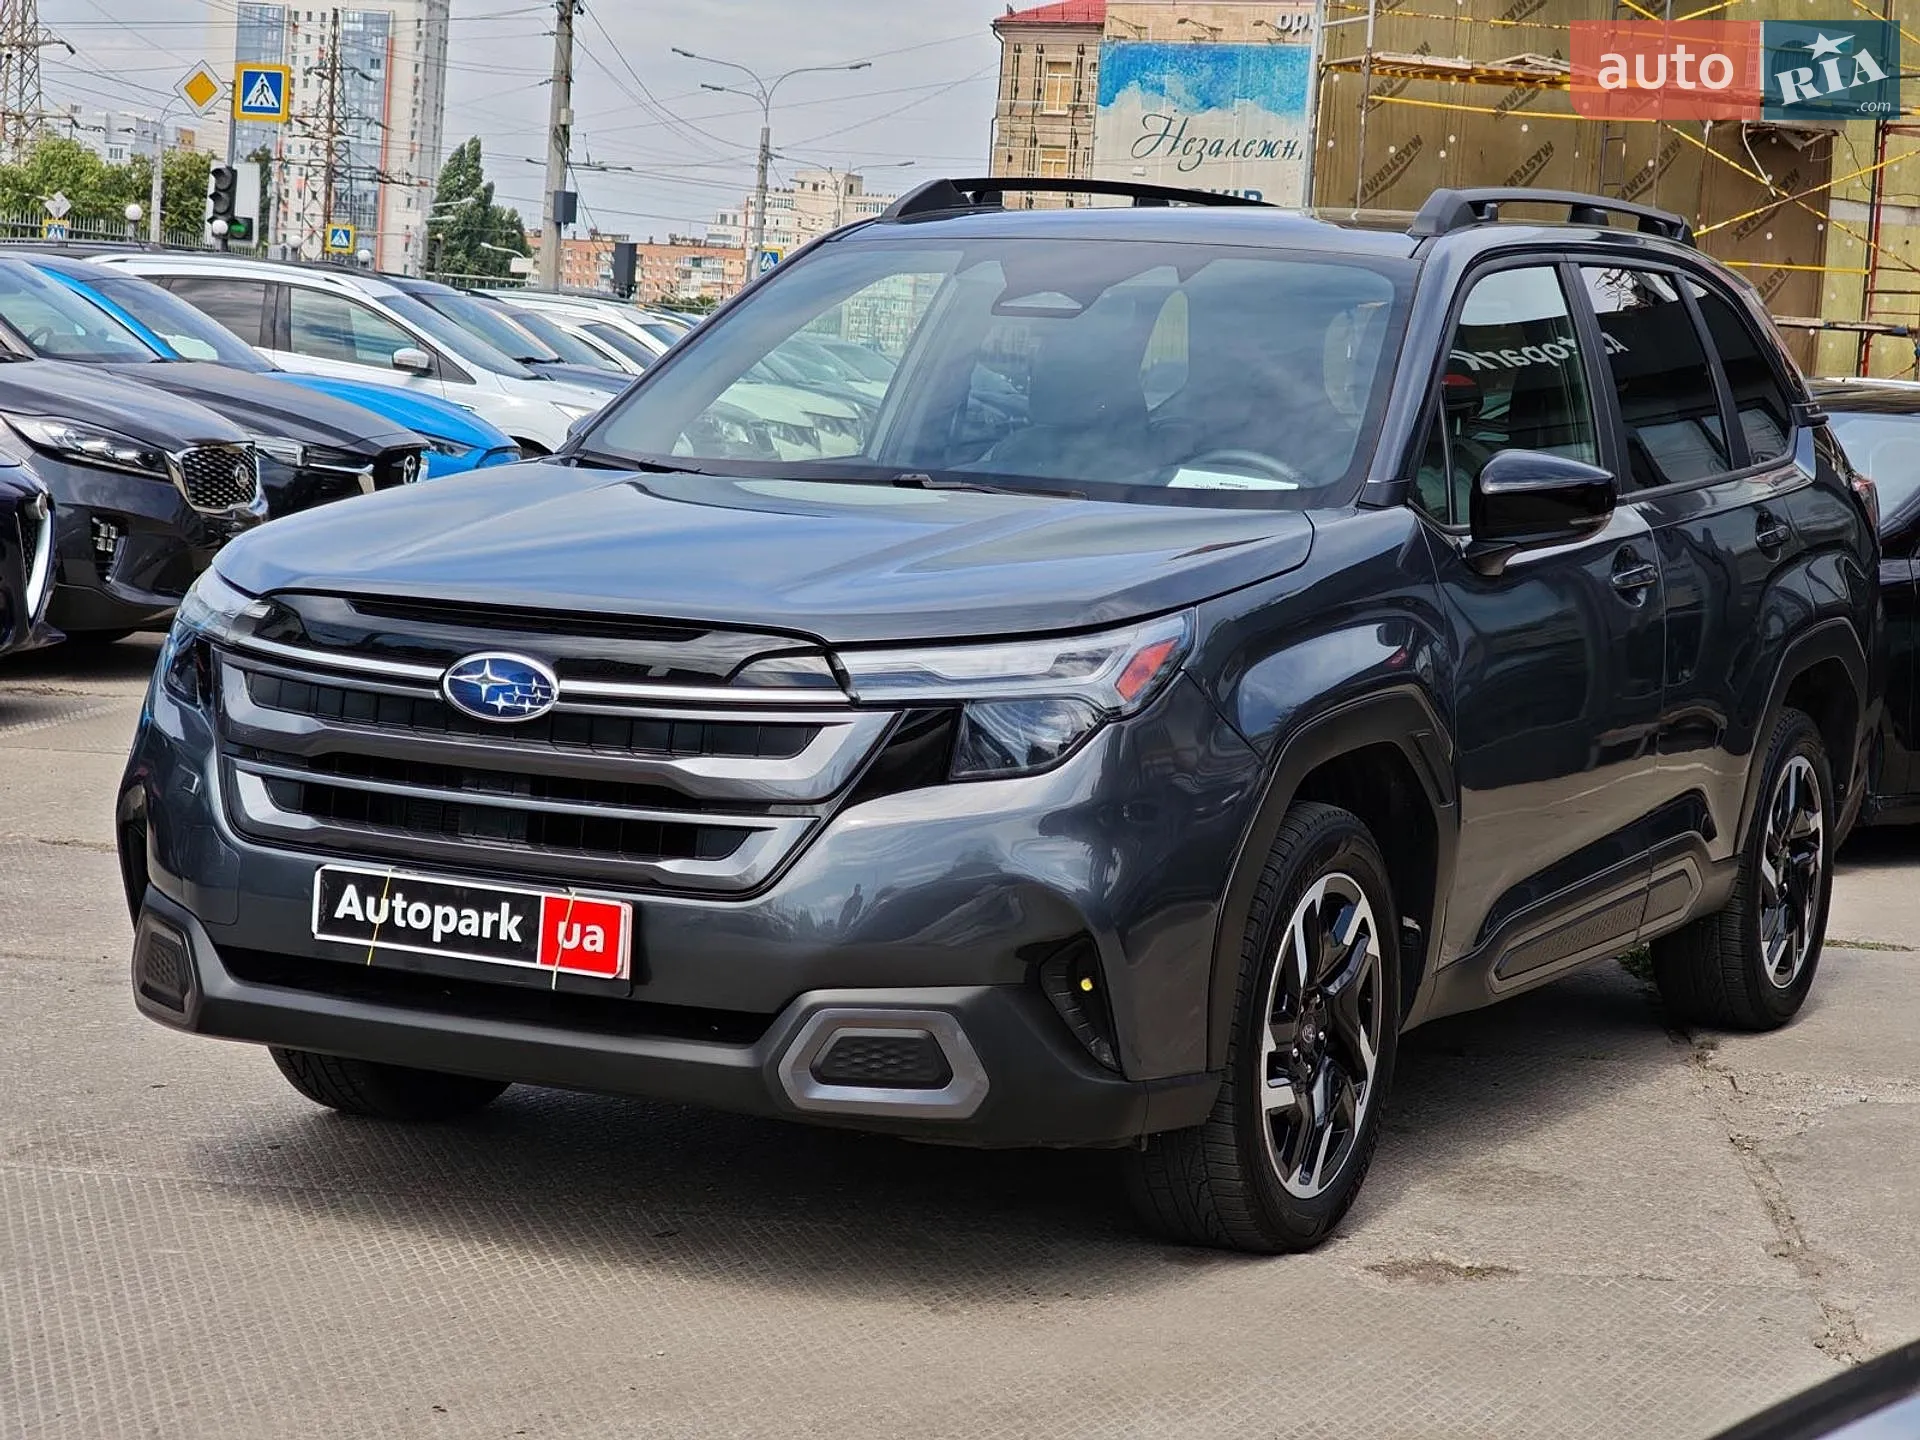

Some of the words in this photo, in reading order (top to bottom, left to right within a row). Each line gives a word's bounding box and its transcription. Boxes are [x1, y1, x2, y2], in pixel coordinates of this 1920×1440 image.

[1131, 114, 1303, 172] Незалежн
[333, 883, 524, 943] Autopark
[556, 921, 605, 953] ua
